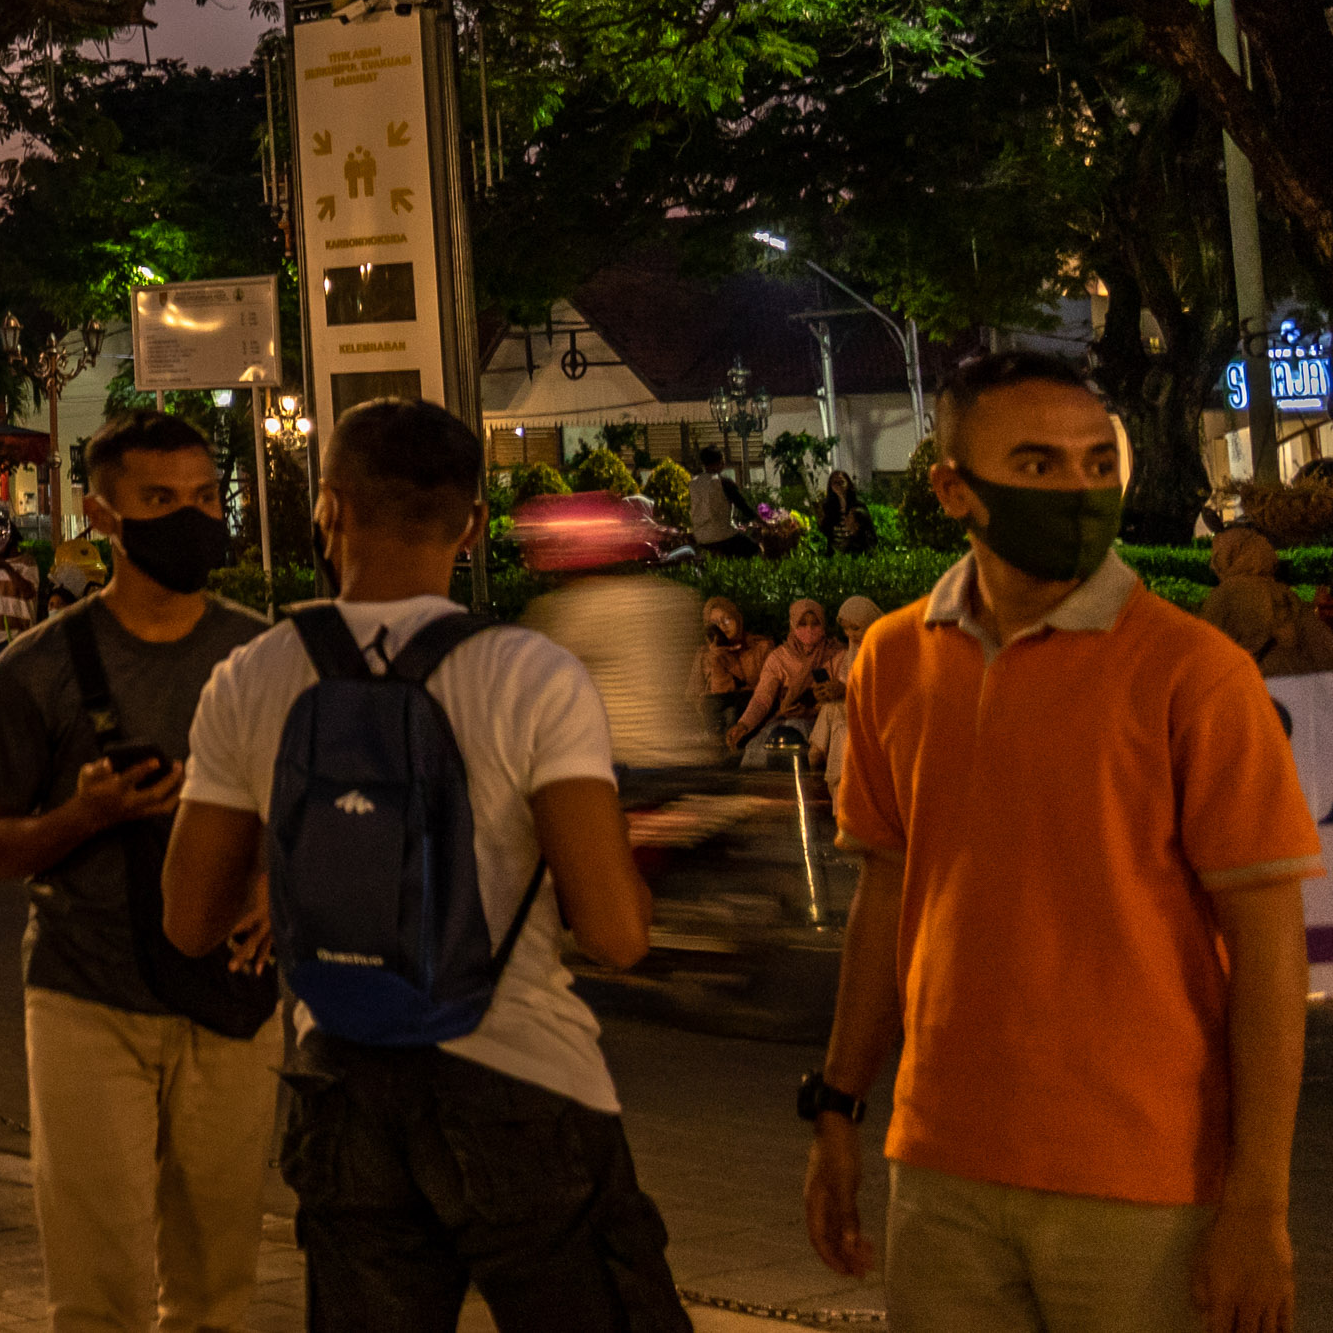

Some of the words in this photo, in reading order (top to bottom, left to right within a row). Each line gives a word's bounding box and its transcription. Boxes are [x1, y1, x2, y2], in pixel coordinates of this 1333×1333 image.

[329, 51, 351, 63] TITIK
[360, 55, 412, 71] EVAKUASI
[333, 72, 378, 87] DARURAT
[325, 233, 408, 250] KARBONDIOKSIDA
[339, 341, 406, 354] KELEMBABAN
